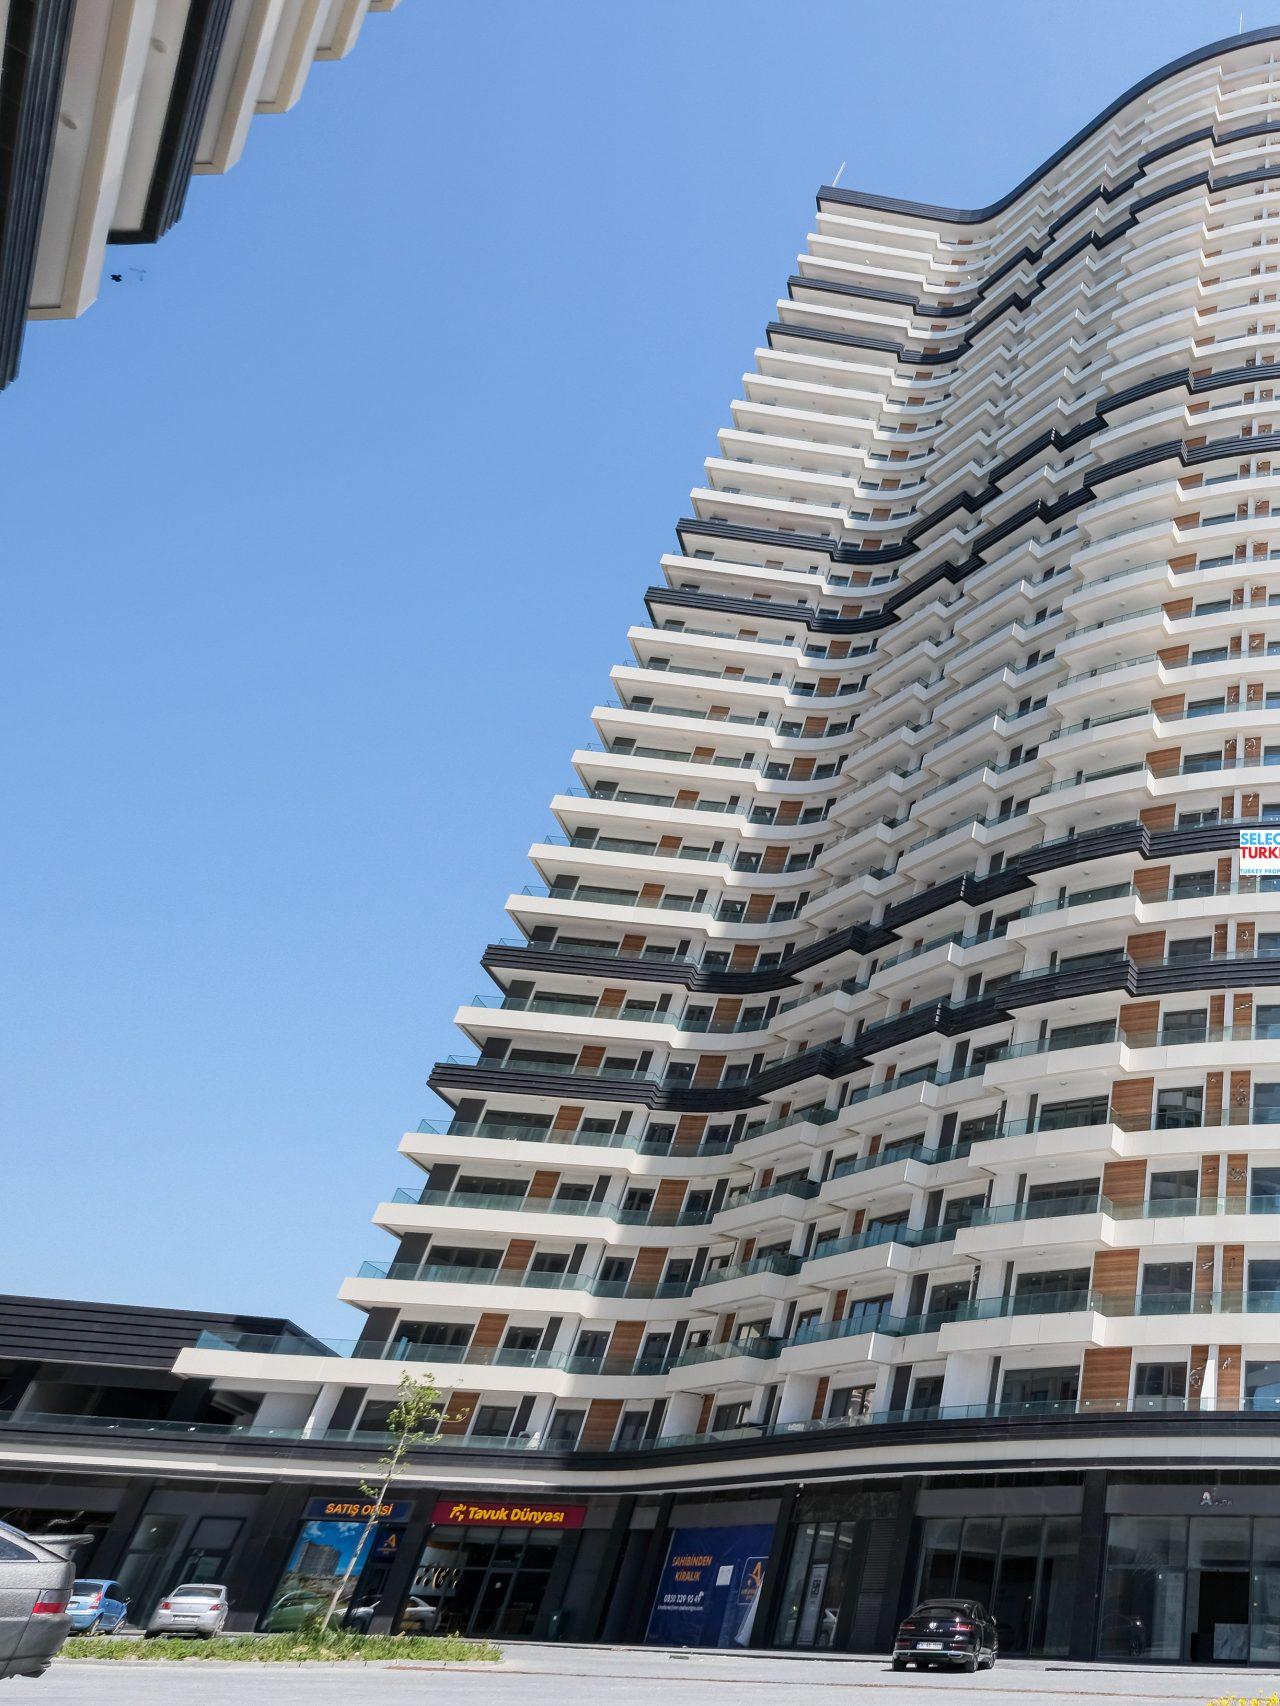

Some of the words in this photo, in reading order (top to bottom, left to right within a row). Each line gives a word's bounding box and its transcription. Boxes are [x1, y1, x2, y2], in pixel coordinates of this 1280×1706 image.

[325, 1503, 360, 1517] SATIŞ
[468, 1507, 509, 1520] Tavuk
[510, 1508, 565, 1524] Dünyası
